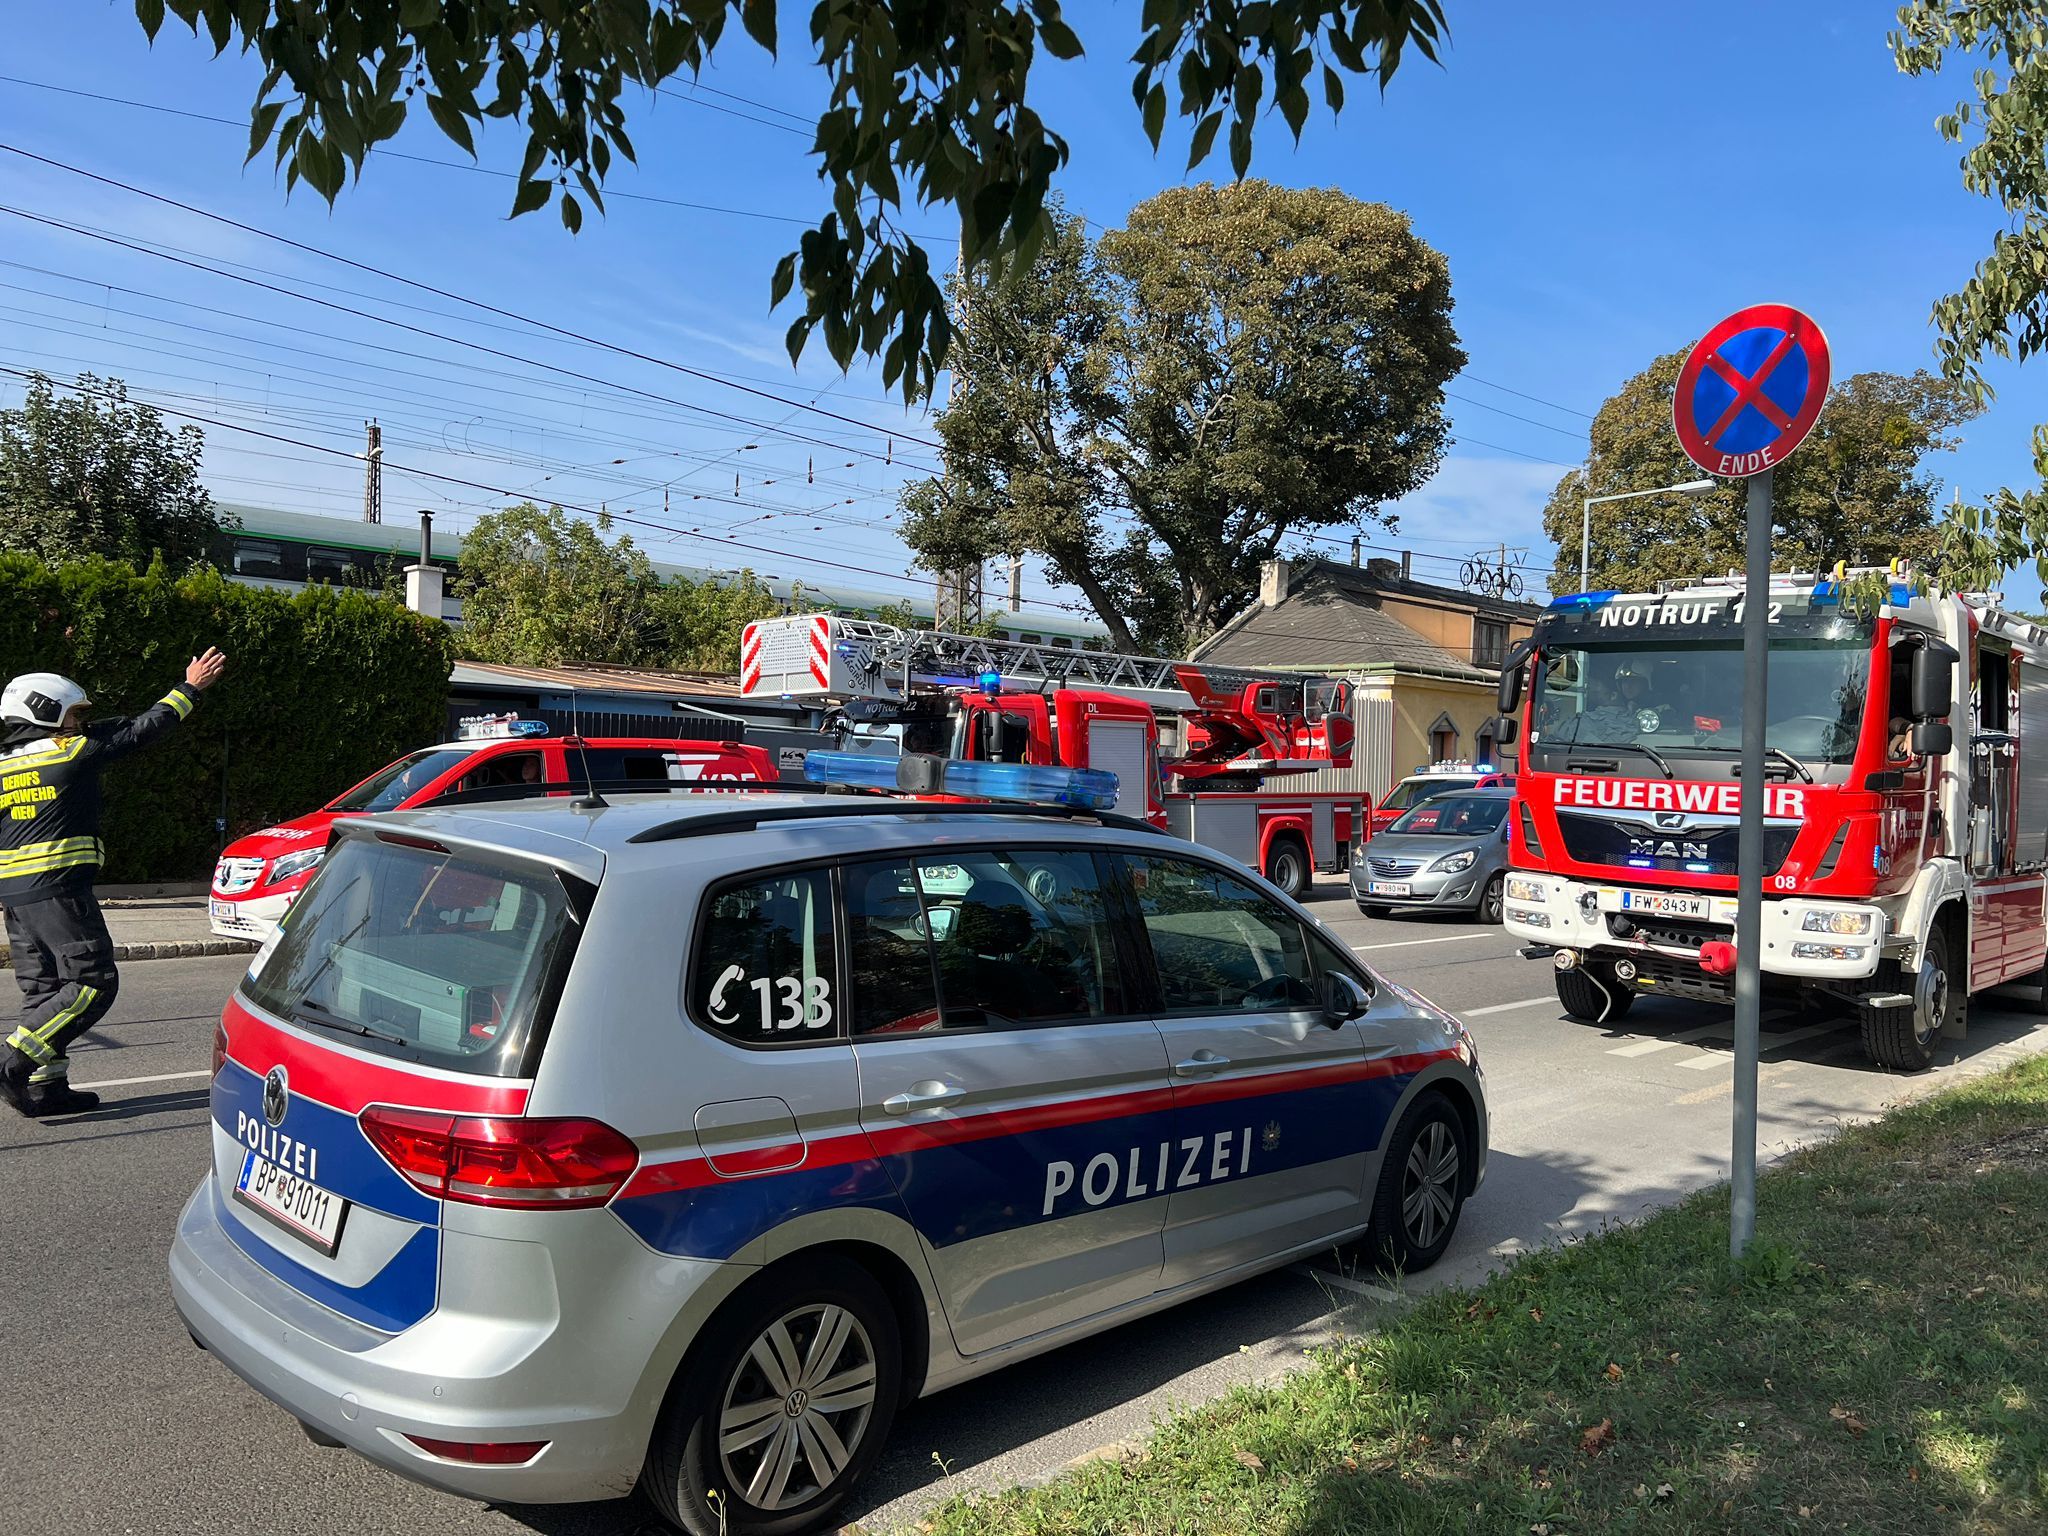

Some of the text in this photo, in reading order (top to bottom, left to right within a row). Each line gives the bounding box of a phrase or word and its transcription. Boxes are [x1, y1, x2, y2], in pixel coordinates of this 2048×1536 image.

[1718, 445, 1775, 474] ENDE
[1600, 601, 1783, 628] NOTRUF 12
[840, 653, 867, 691] MAGIRUS
[903, 701, 917, 711] 22
[1088, 703, 1099, 713] DL
[2, 770, 41, 791] BERUFS
[1630, 838, 1708, 859] MAN
[1878, 856, 1890, 875] 08
[1774, 875, 1797, 890] 08
[1634, 895, 1700, 914] FW 343 W
[750, 976, 832, 1029] 133
[237, 1110, 317, 1180] POLIZEI
[1043, 1127, 1252, 1216] POLIZEI
[255, 1159, 330, 1231] BP 91011
